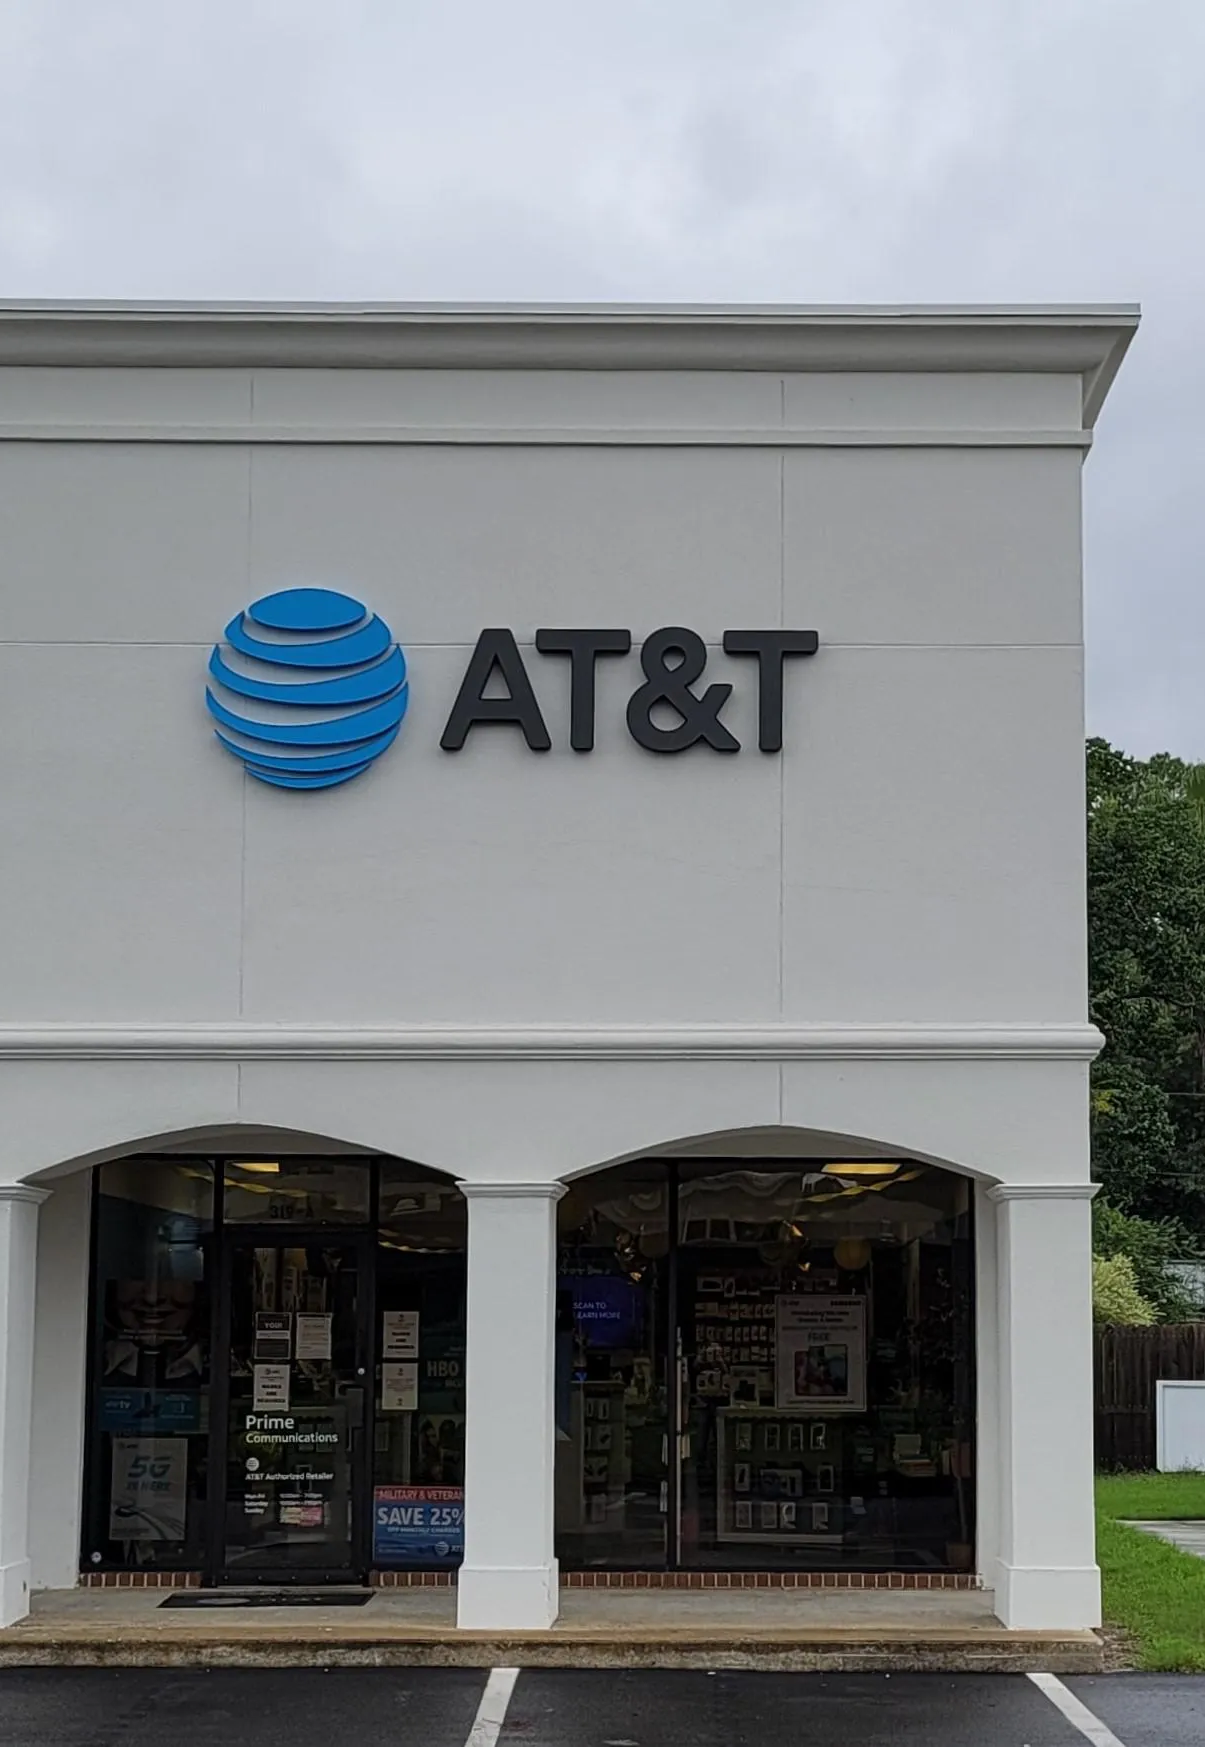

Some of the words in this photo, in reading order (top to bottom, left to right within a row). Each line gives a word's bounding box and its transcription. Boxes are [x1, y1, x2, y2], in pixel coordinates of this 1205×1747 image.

[439, 626, 819, 753] AT&T
[427, 1360, 459, 1377] HBO
[245, 1414, 295, 1430] Prime
[245, 1432, 339, 1443] Communications
[128, 1455, 174, 1478] 5G
[265, 1472, 305, 1480] Authorized
[306, 1472, 334, 1480] Retailer
[379, 1489, 416, 1500] MILITARY
[417, 1490, 426, 1500] &
[427, 1490, 463, 1500] VETERA
[377, 1507, 424, 1526] SAVE
